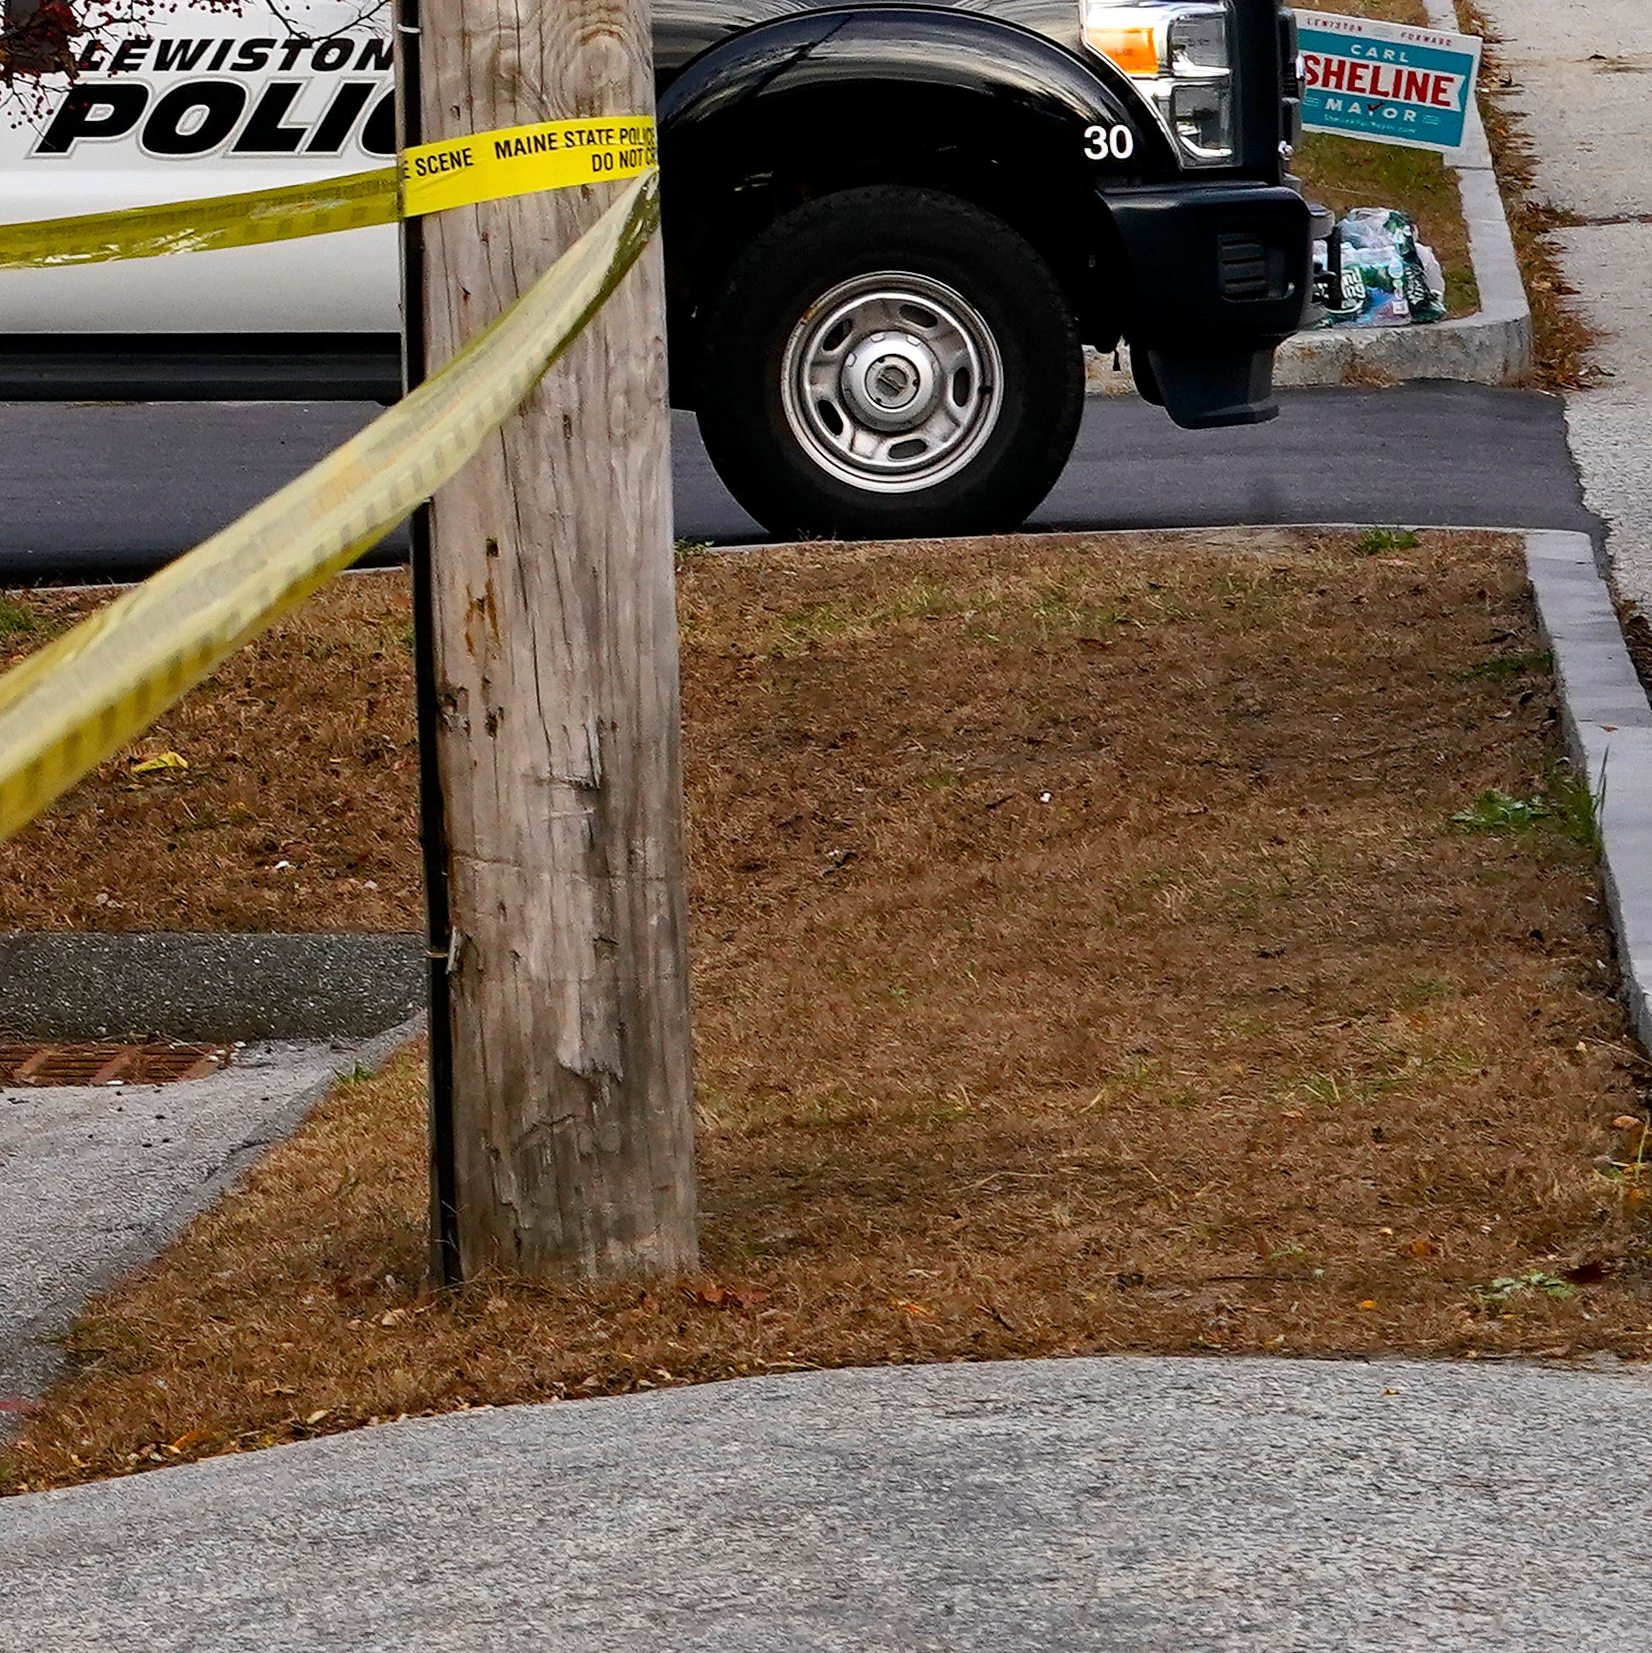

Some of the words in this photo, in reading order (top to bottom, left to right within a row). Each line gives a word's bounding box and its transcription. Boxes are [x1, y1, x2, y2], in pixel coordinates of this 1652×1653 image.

[77, 38, 395, 71] LEWISTON
[1350, 44, 1409, 63] CARL
[1303, 54, 1455, 108] SHELINE
[1325, 98, 1417, 123] MAYOR
[415, 148, 474, 178] SCENE
[494, 132, 559, 161] MAINE
[563, 128, 615, 148] STATE
[1084, 125, 1134, 160] 30
[592, 151, 614, 173] DO
[619, 148, 643, 168] NOT
